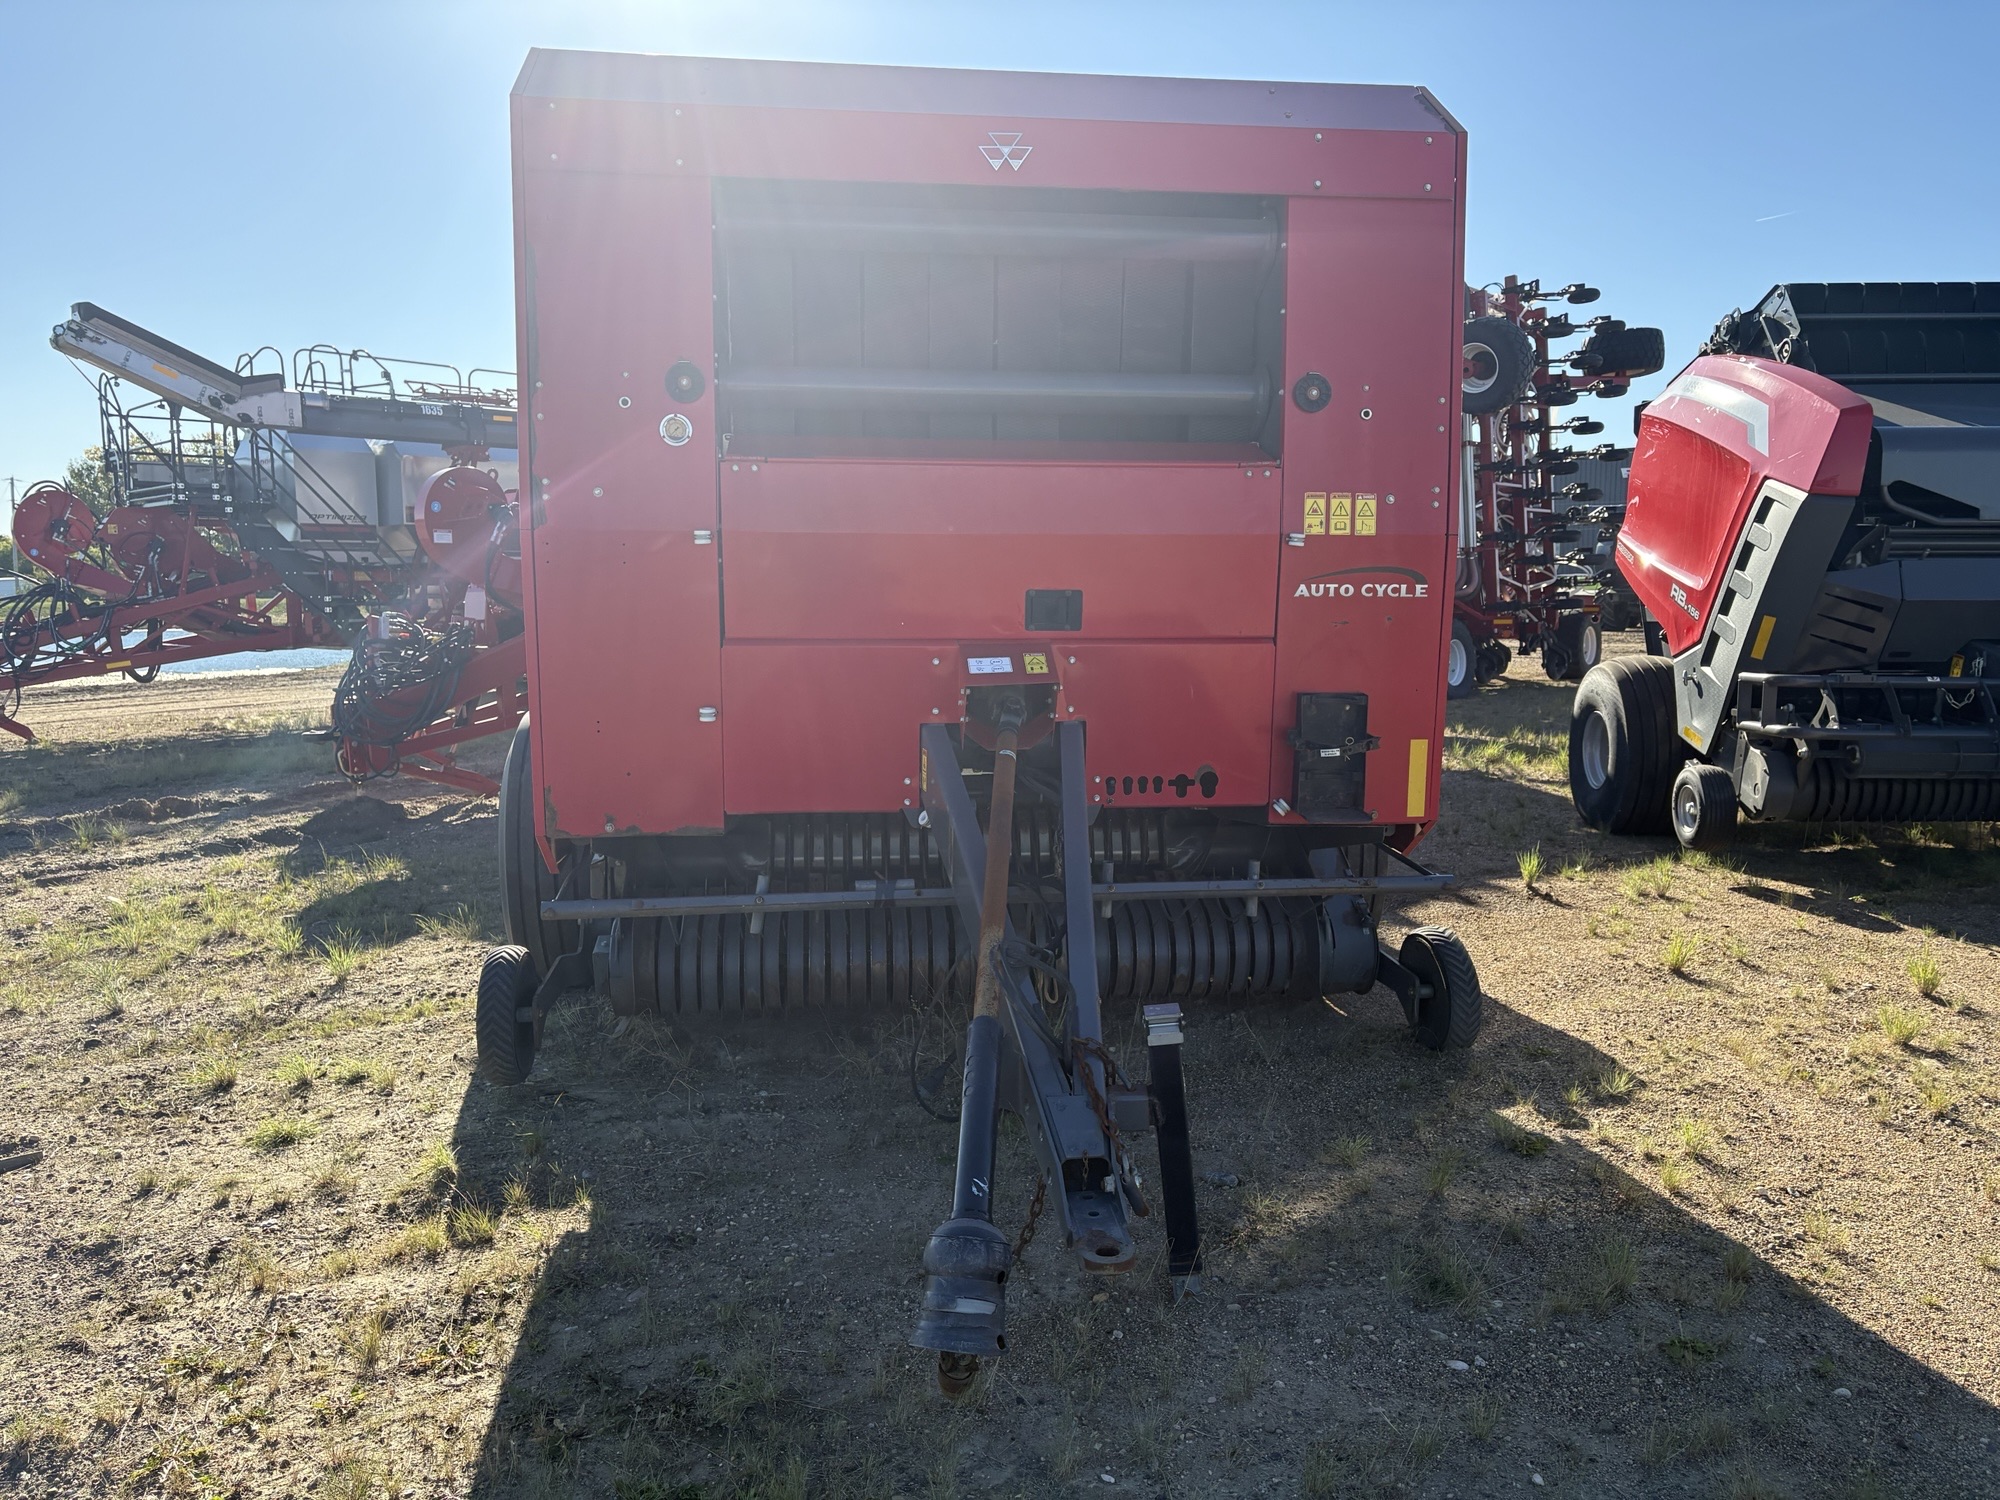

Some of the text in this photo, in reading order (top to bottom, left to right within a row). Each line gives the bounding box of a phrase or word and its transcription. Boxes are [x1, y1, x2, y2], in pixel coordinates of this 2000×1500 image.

[421, 405, 443, 416] 1635
[1294, 583, 1429, 598] AUTO CYCLE
